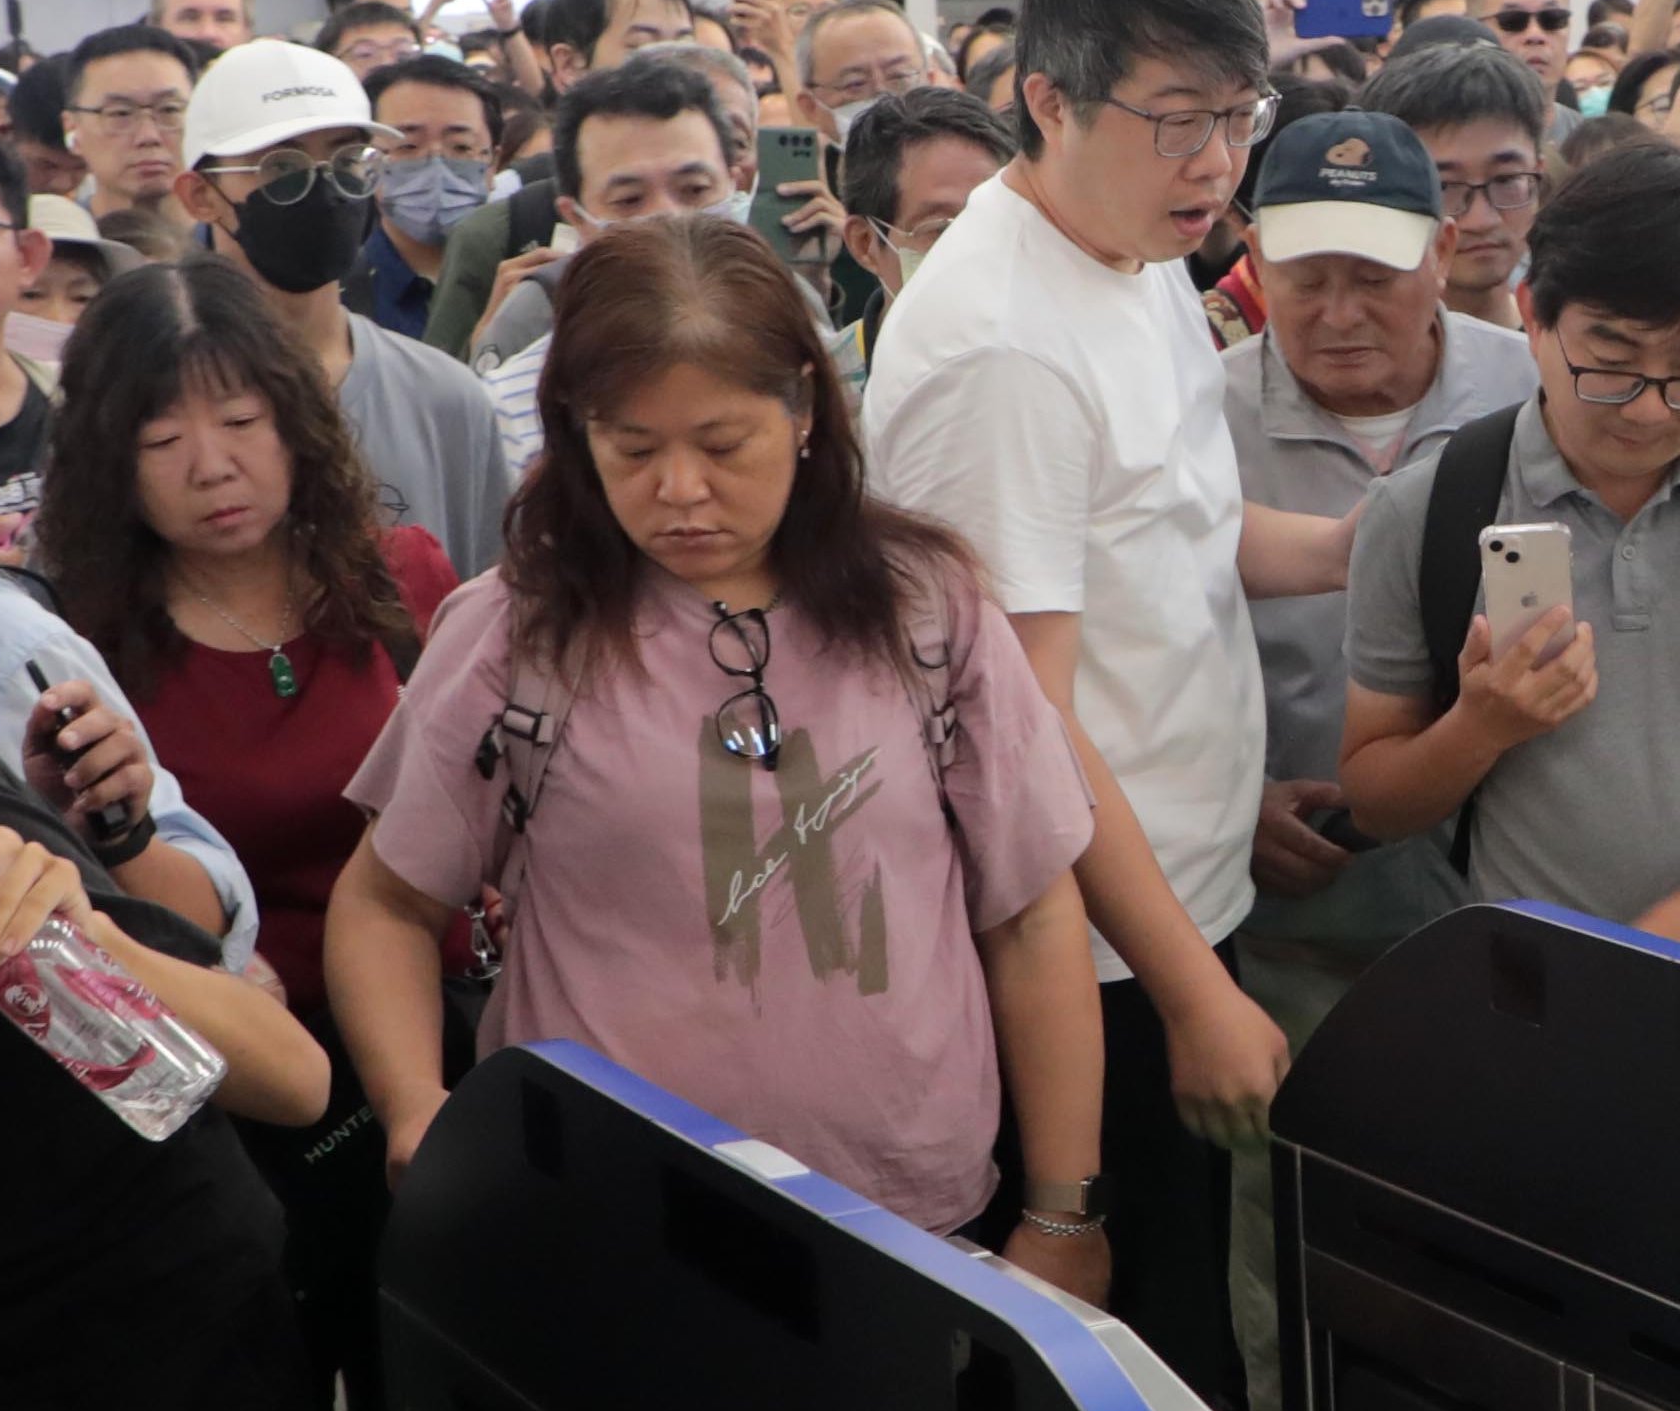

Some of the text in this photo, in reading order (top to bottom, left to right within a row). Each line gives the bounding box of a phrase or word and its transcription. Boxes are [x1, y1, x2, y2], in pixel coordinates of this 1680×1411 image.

[262, 86, 338, 103] FORMOSA
[1318, 167, 1377, 181] PEANUTS
[303, 1104, 374, 1165] HUNTE
